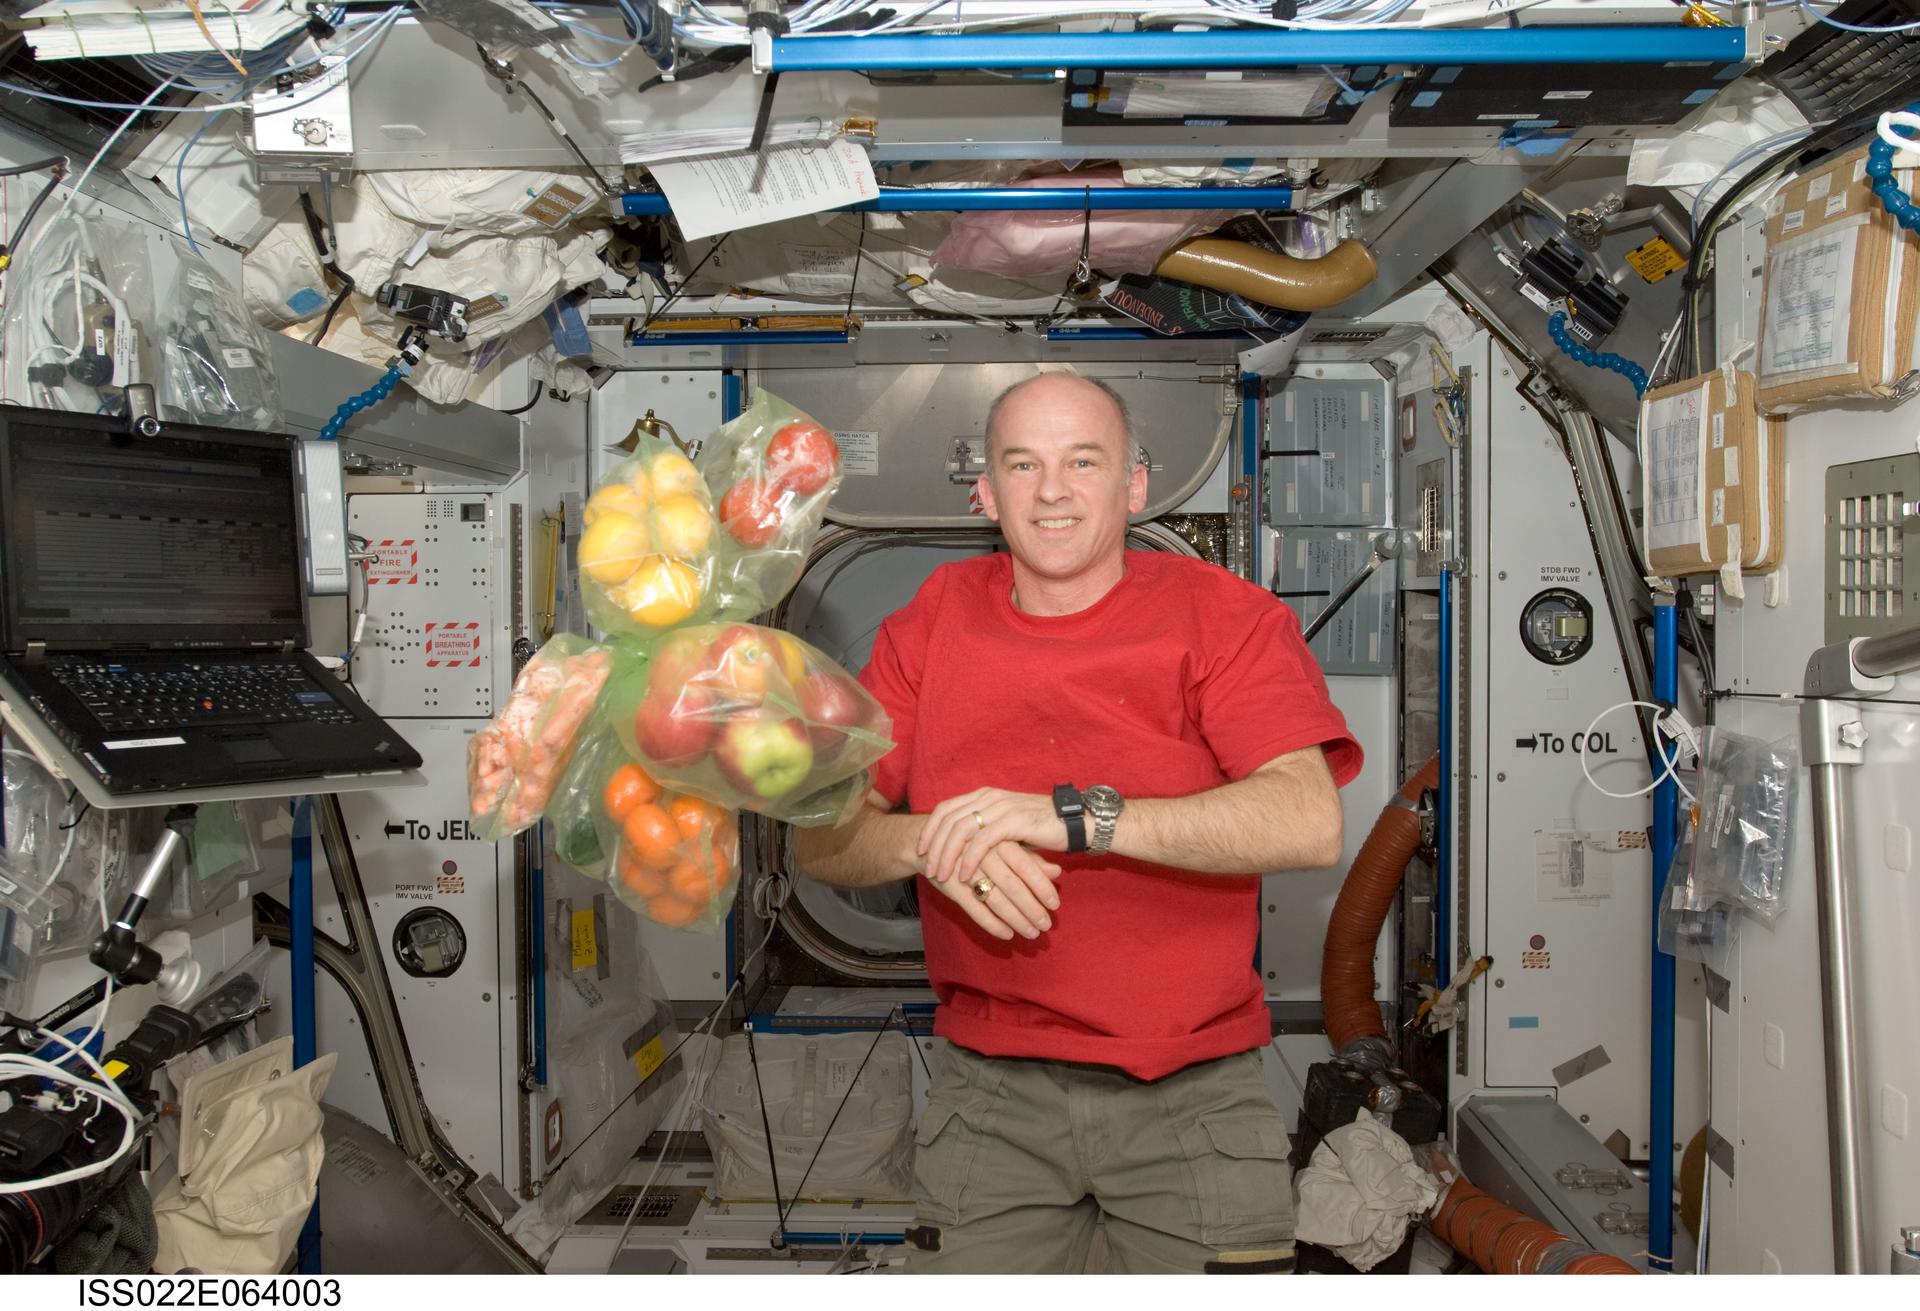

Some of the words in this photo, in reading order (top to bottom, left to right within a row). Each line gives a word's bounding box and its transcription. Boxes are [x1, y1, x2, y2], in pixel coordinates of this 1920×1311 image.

[1113, 289, 1164, 328] ENDEAVOU
[380, 559, 401, 567] FIRE
[1539, 732, 1565, 754] To
[1571, 732, 1618, 753] COL
[405, 819, 431, 841] To
[395, 884, 415, 892] PORT
